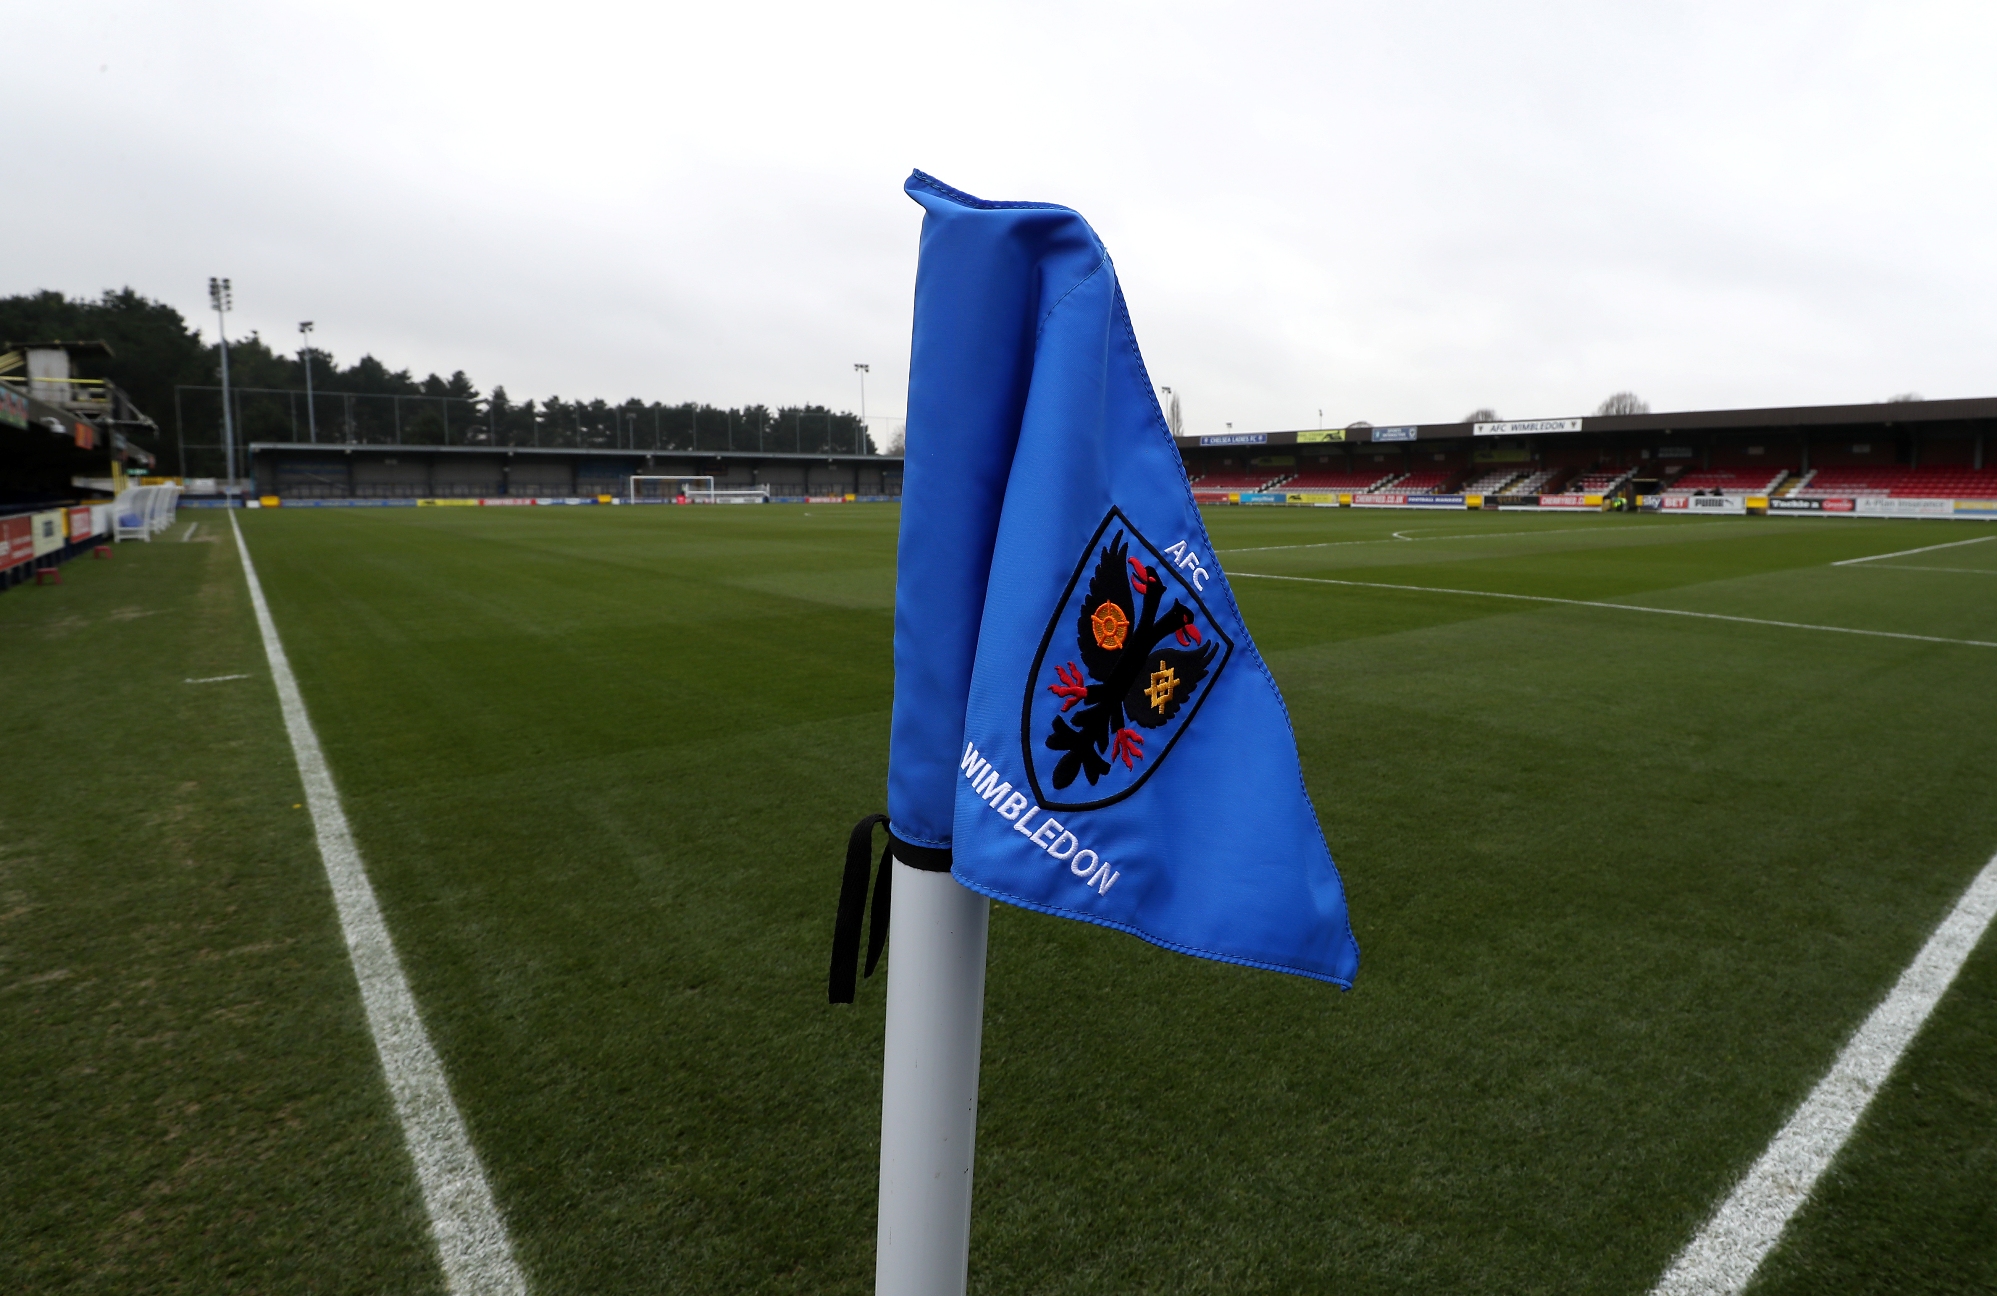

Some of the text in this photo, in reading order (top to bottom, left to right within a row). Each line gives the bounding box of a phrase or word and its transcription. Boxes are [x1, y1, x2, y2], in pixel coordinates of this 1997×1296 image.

[1490, 421, 1566, 432] AFC WIMBLEDON
[1541, 496, 1585, 505] CHERRYRED.C
[1643, 496, 1686, 509] sky BET
[1695, 498, 1724, 507] PUMA
[1164, 540, 1209, 591] AFC
[960, 741, 1120, 897] WIMBLEDON
